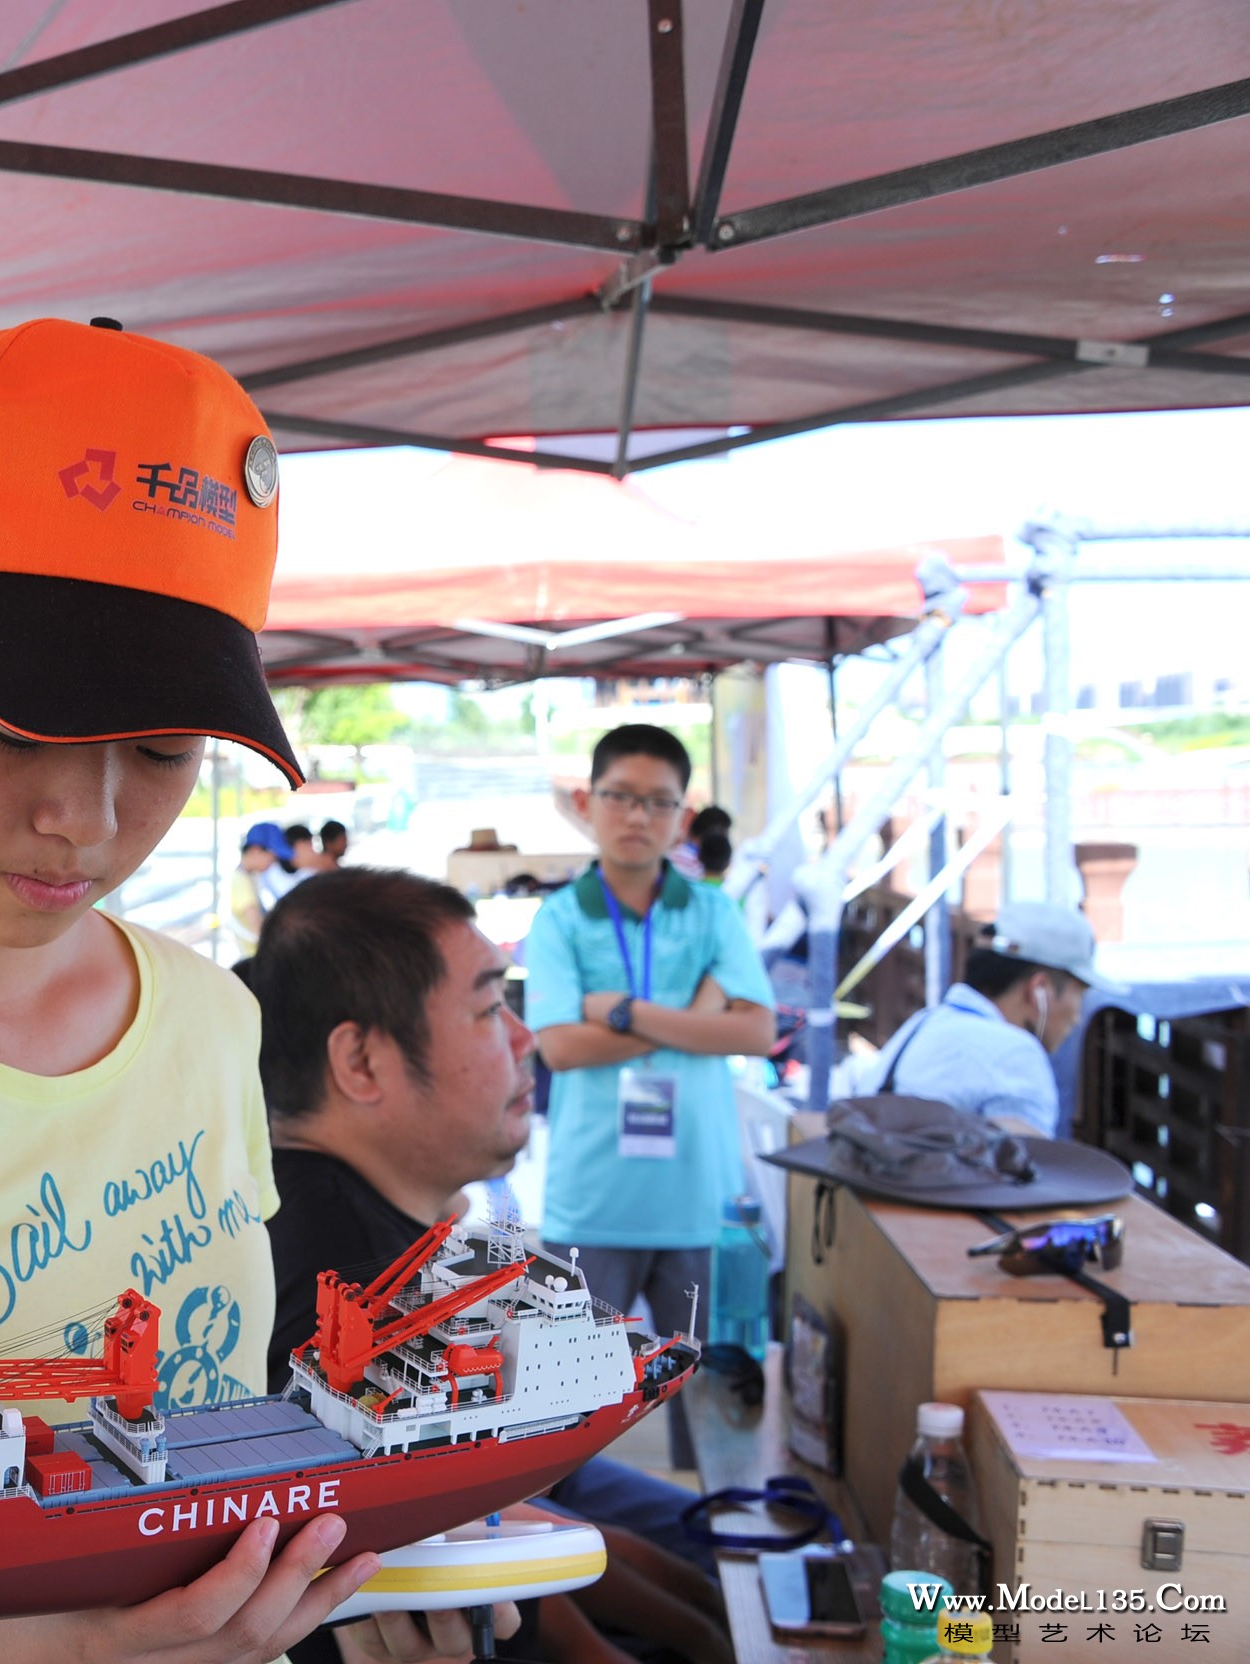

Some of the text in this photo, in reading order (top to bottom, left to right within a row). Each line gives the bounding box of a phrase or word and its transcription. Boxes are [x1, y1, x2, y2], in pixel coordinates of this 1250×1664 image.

[103, 1129, 205, 1220] away
[131, 1189, 261, 1297] with me
[138, 1480, 341, 1537] CHINARE
